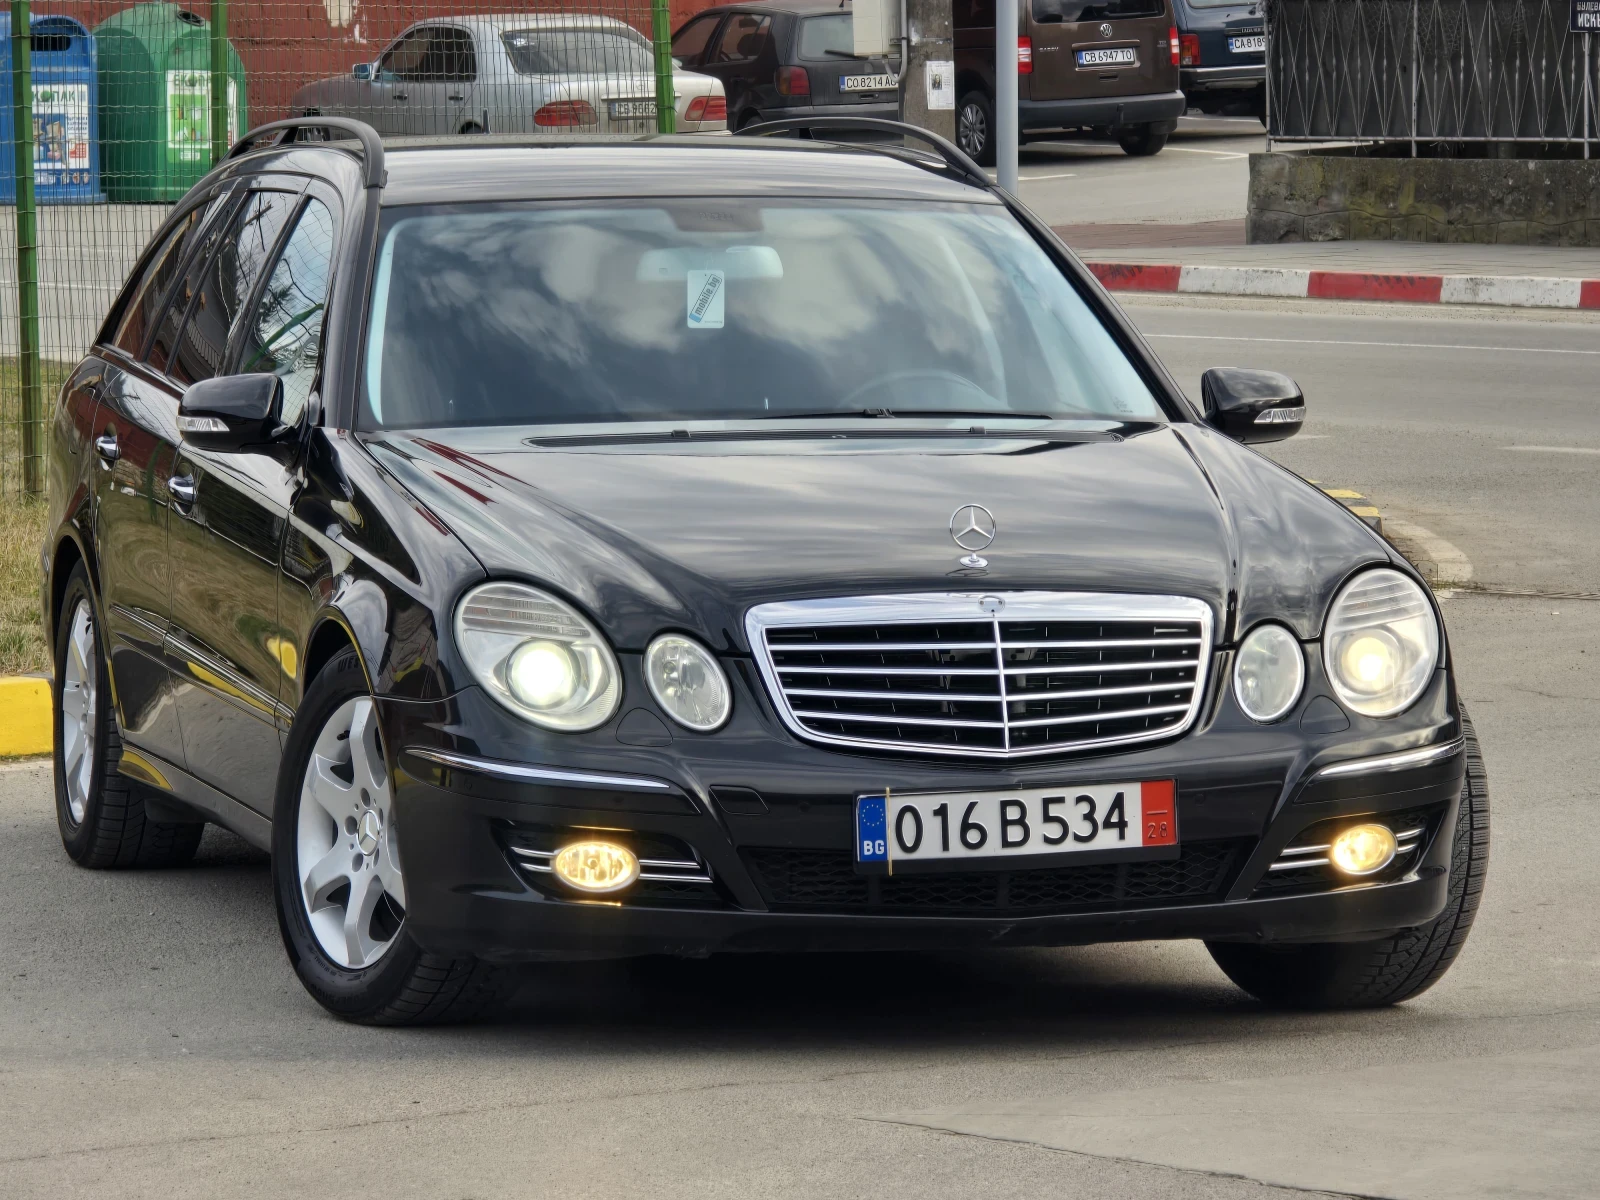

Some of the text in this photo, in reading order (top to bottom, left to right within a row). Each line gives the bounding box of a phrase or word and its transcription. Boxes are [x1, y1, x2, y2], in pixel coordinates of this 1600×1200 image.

[1577, 2, 1600, 11] БУЛЕВ
[1098, 50, 1118, 62] 6947
[694, 276, 721, 316] mobile.bg
[1147, 821, 1168, 839] 28
[863, 839, 885, 856] BG
